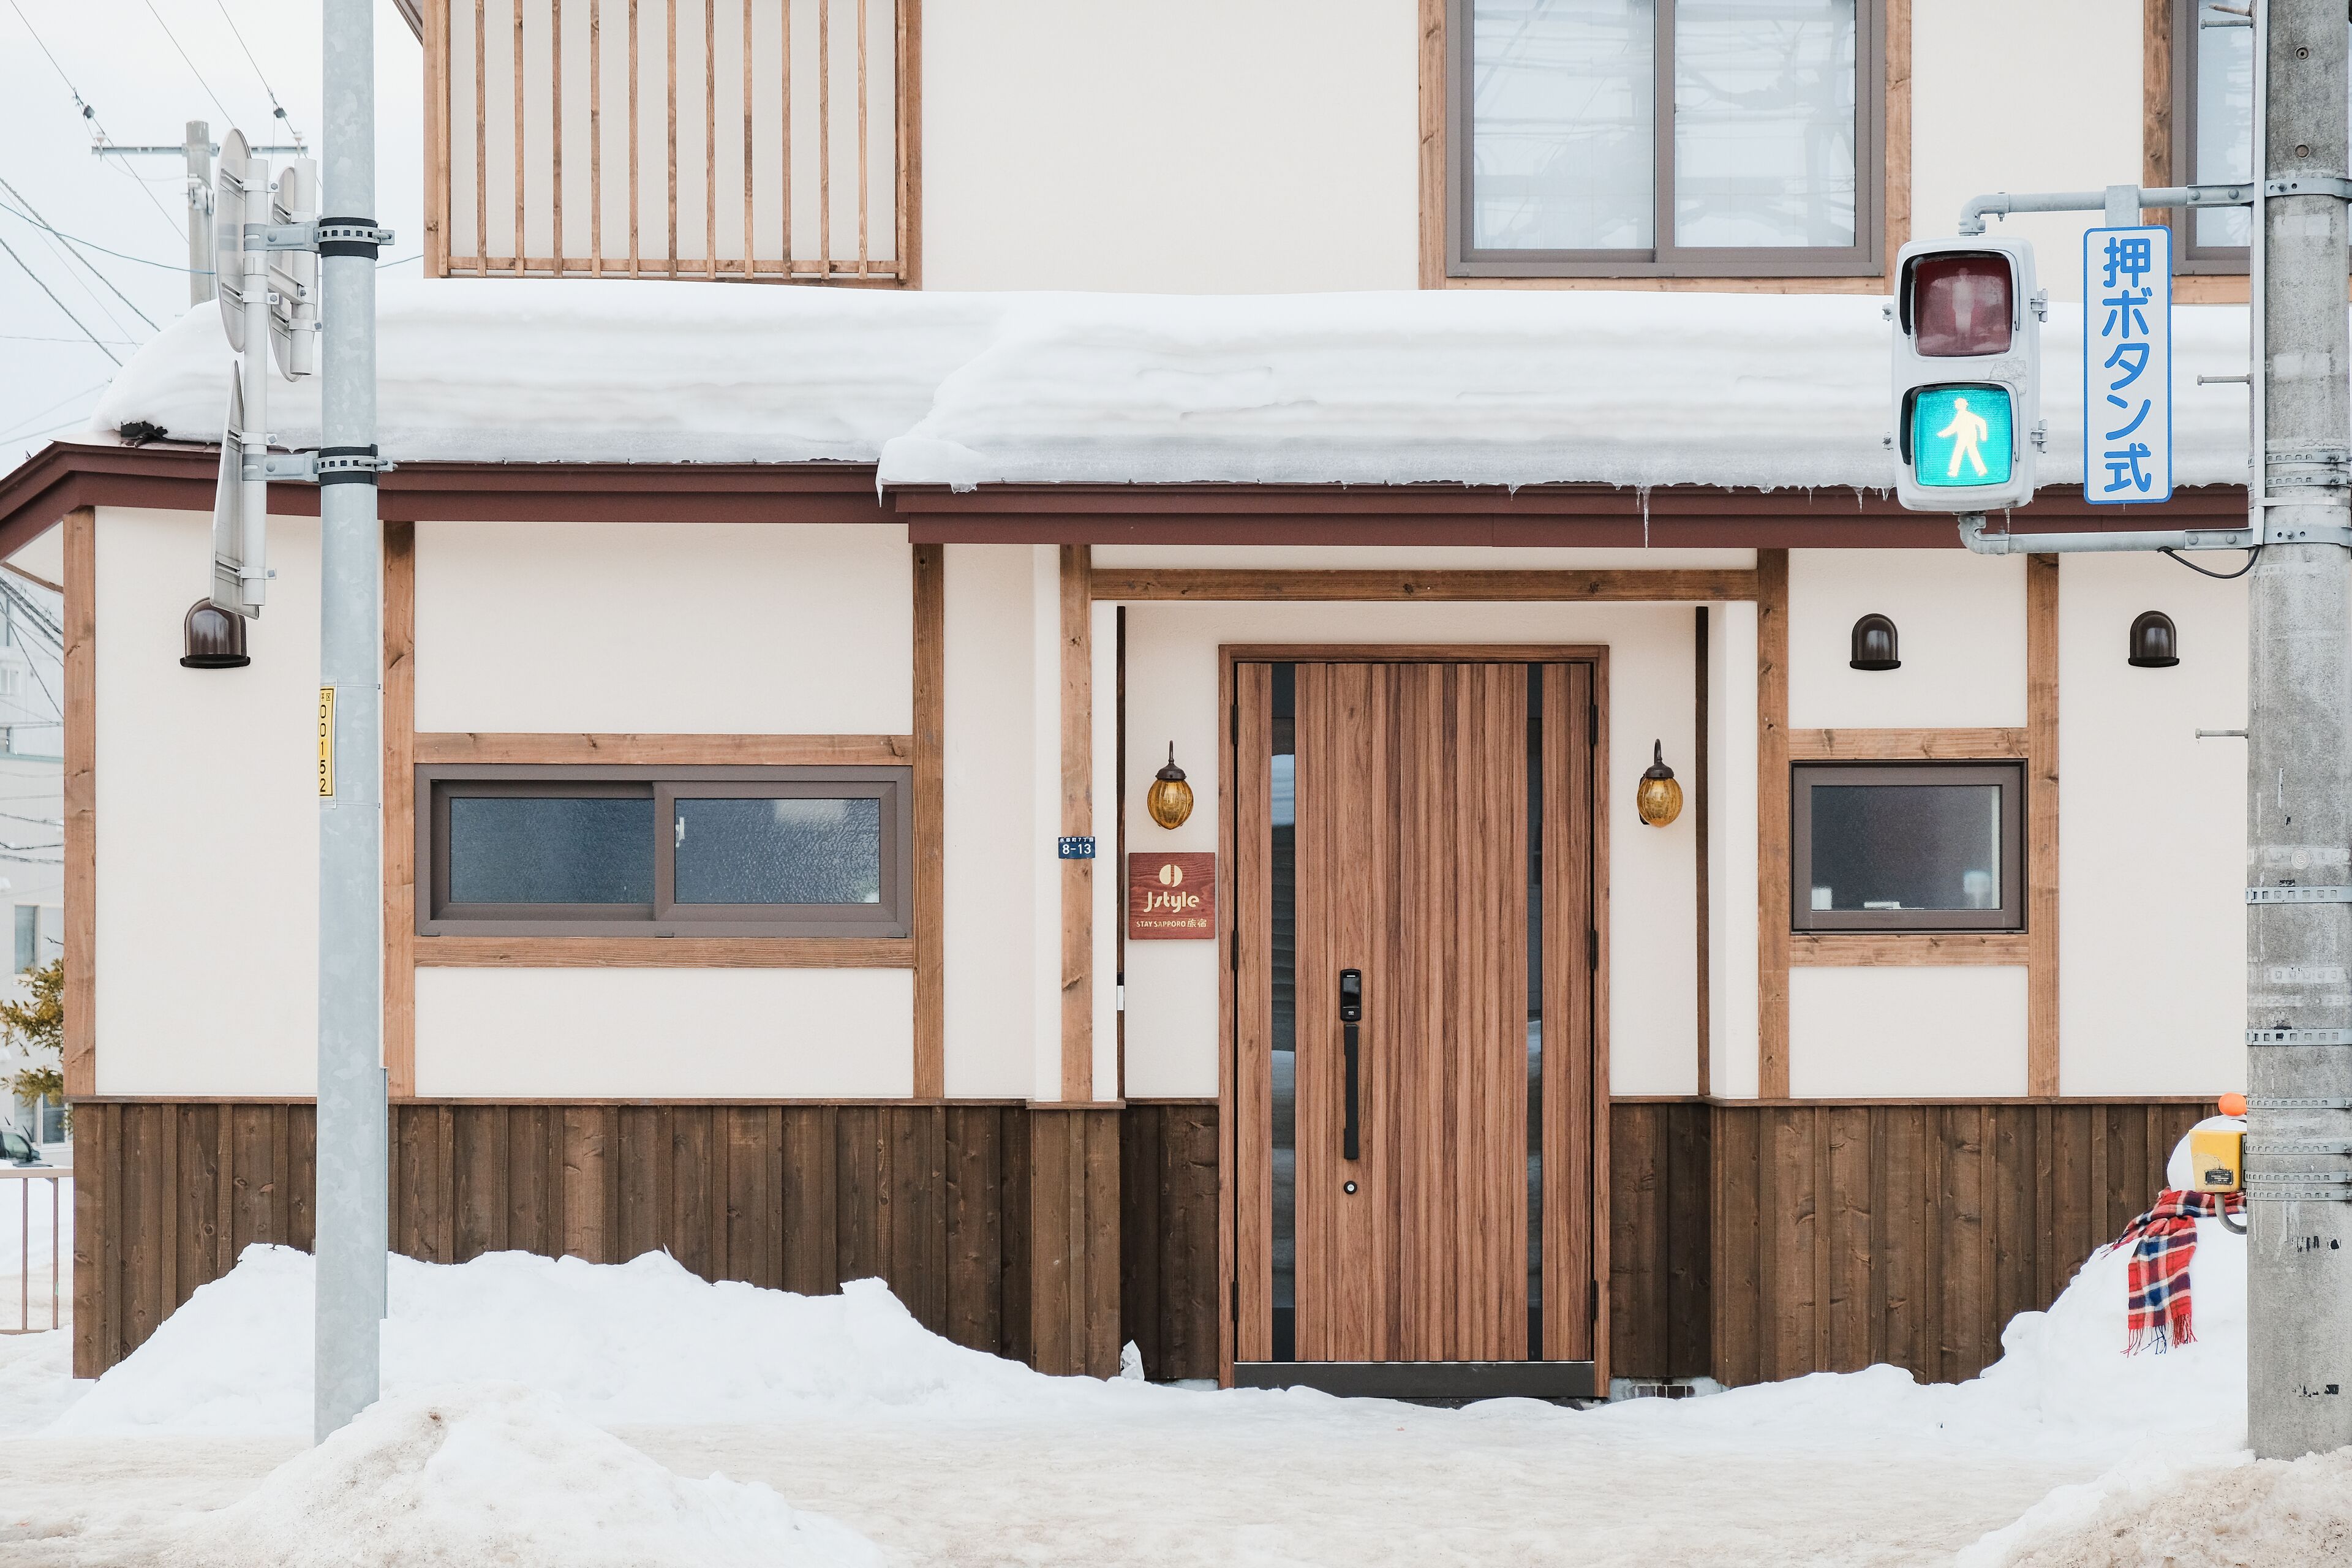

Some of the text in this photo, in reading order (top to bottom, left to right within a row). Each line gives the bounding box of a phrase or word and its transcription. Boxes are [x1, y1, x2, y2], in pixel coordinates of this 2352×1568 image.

[2101, 236, 2153, 492] 押ボタン式
[1062, 843, 1091, 854] 8-13
[1187, 919, 1207, 928] 旅宿
